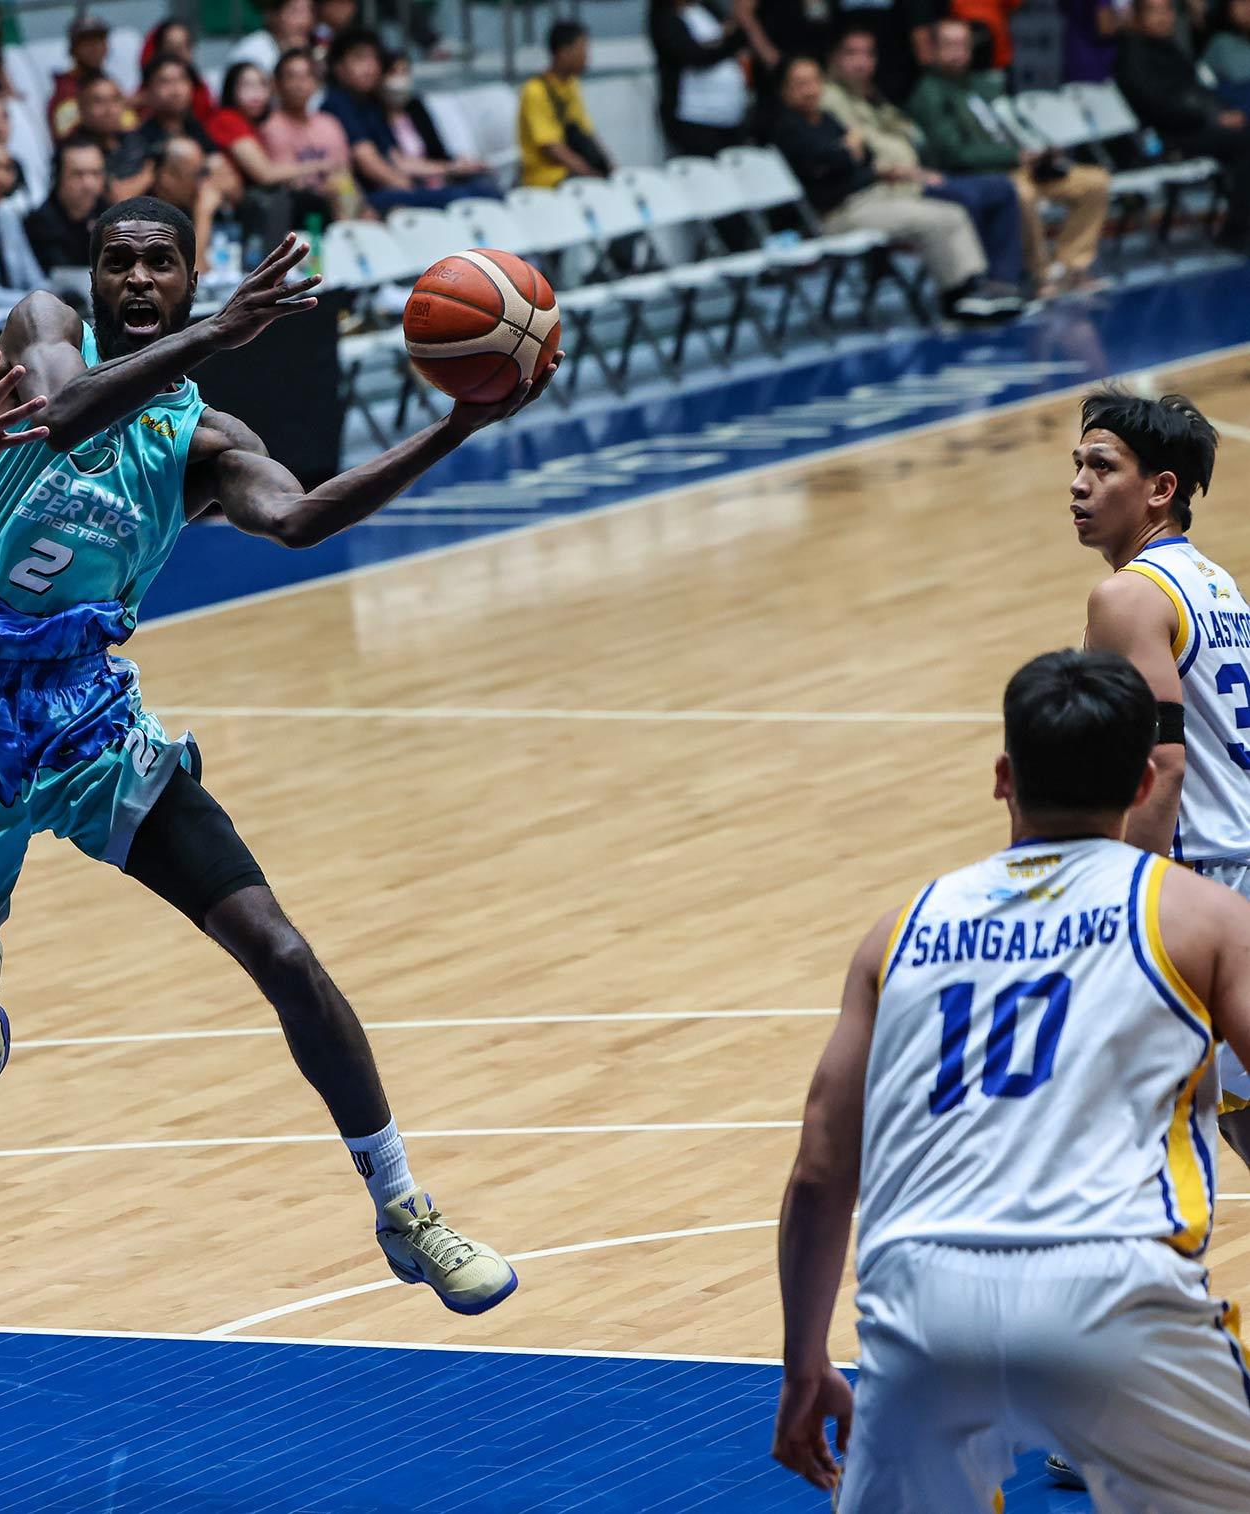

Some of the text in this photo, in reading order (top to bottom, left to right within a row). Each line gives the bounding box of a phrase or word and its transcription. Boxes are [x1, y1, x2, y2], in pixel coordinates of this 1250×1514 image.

[24, 484, 138, 537] PER LPG
[9, 537, 74, 596] 2
[123, 727, 159, 777] 2
[911, 905, 1121, 968] SANGALANG
[928, 971, 1072, 1116] 10
